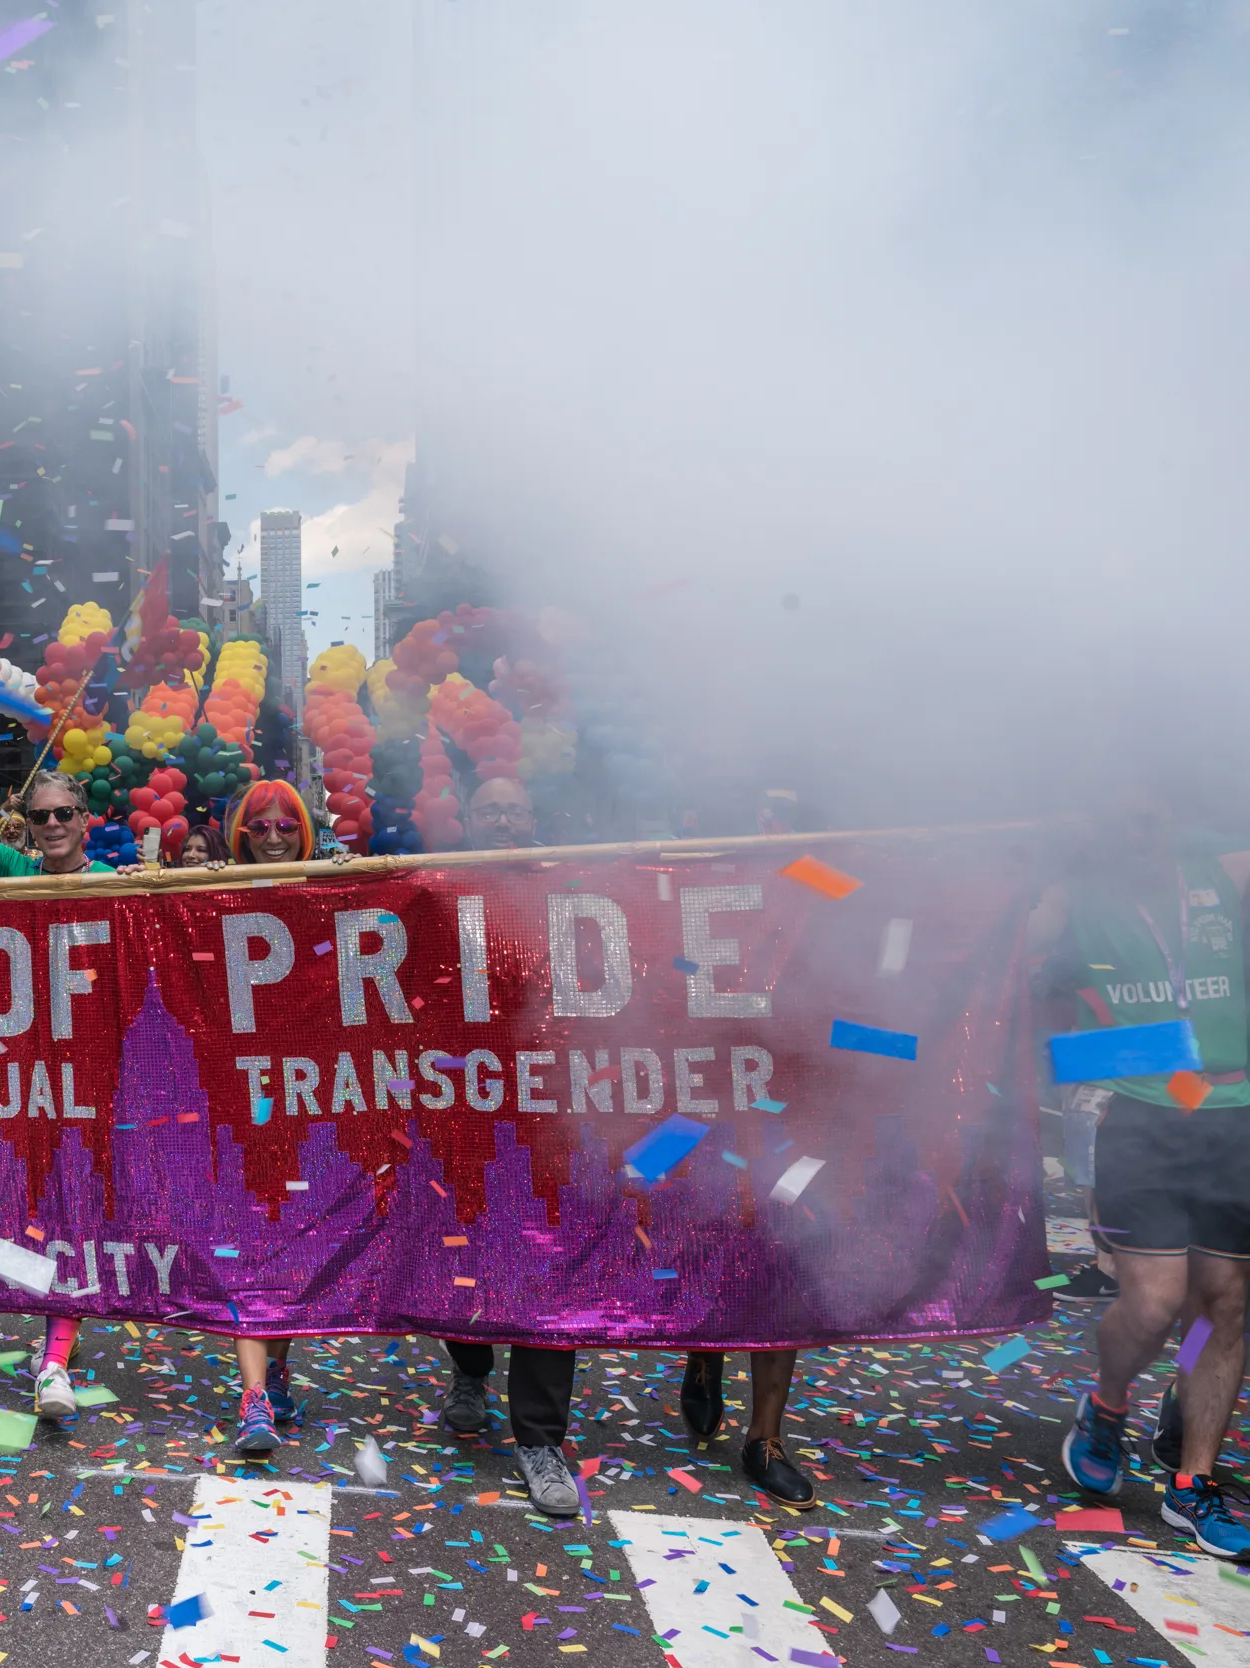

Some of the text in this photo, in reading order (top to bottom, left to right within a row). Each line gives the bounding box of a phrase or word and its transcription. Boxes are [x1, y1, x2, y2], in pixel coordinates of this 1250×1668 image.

[221, 884, 773, 1033] PRIDE
[236, 1046, 774, 1117] TRANSGENDER
[45, 1239, 178, 1297] CITY
